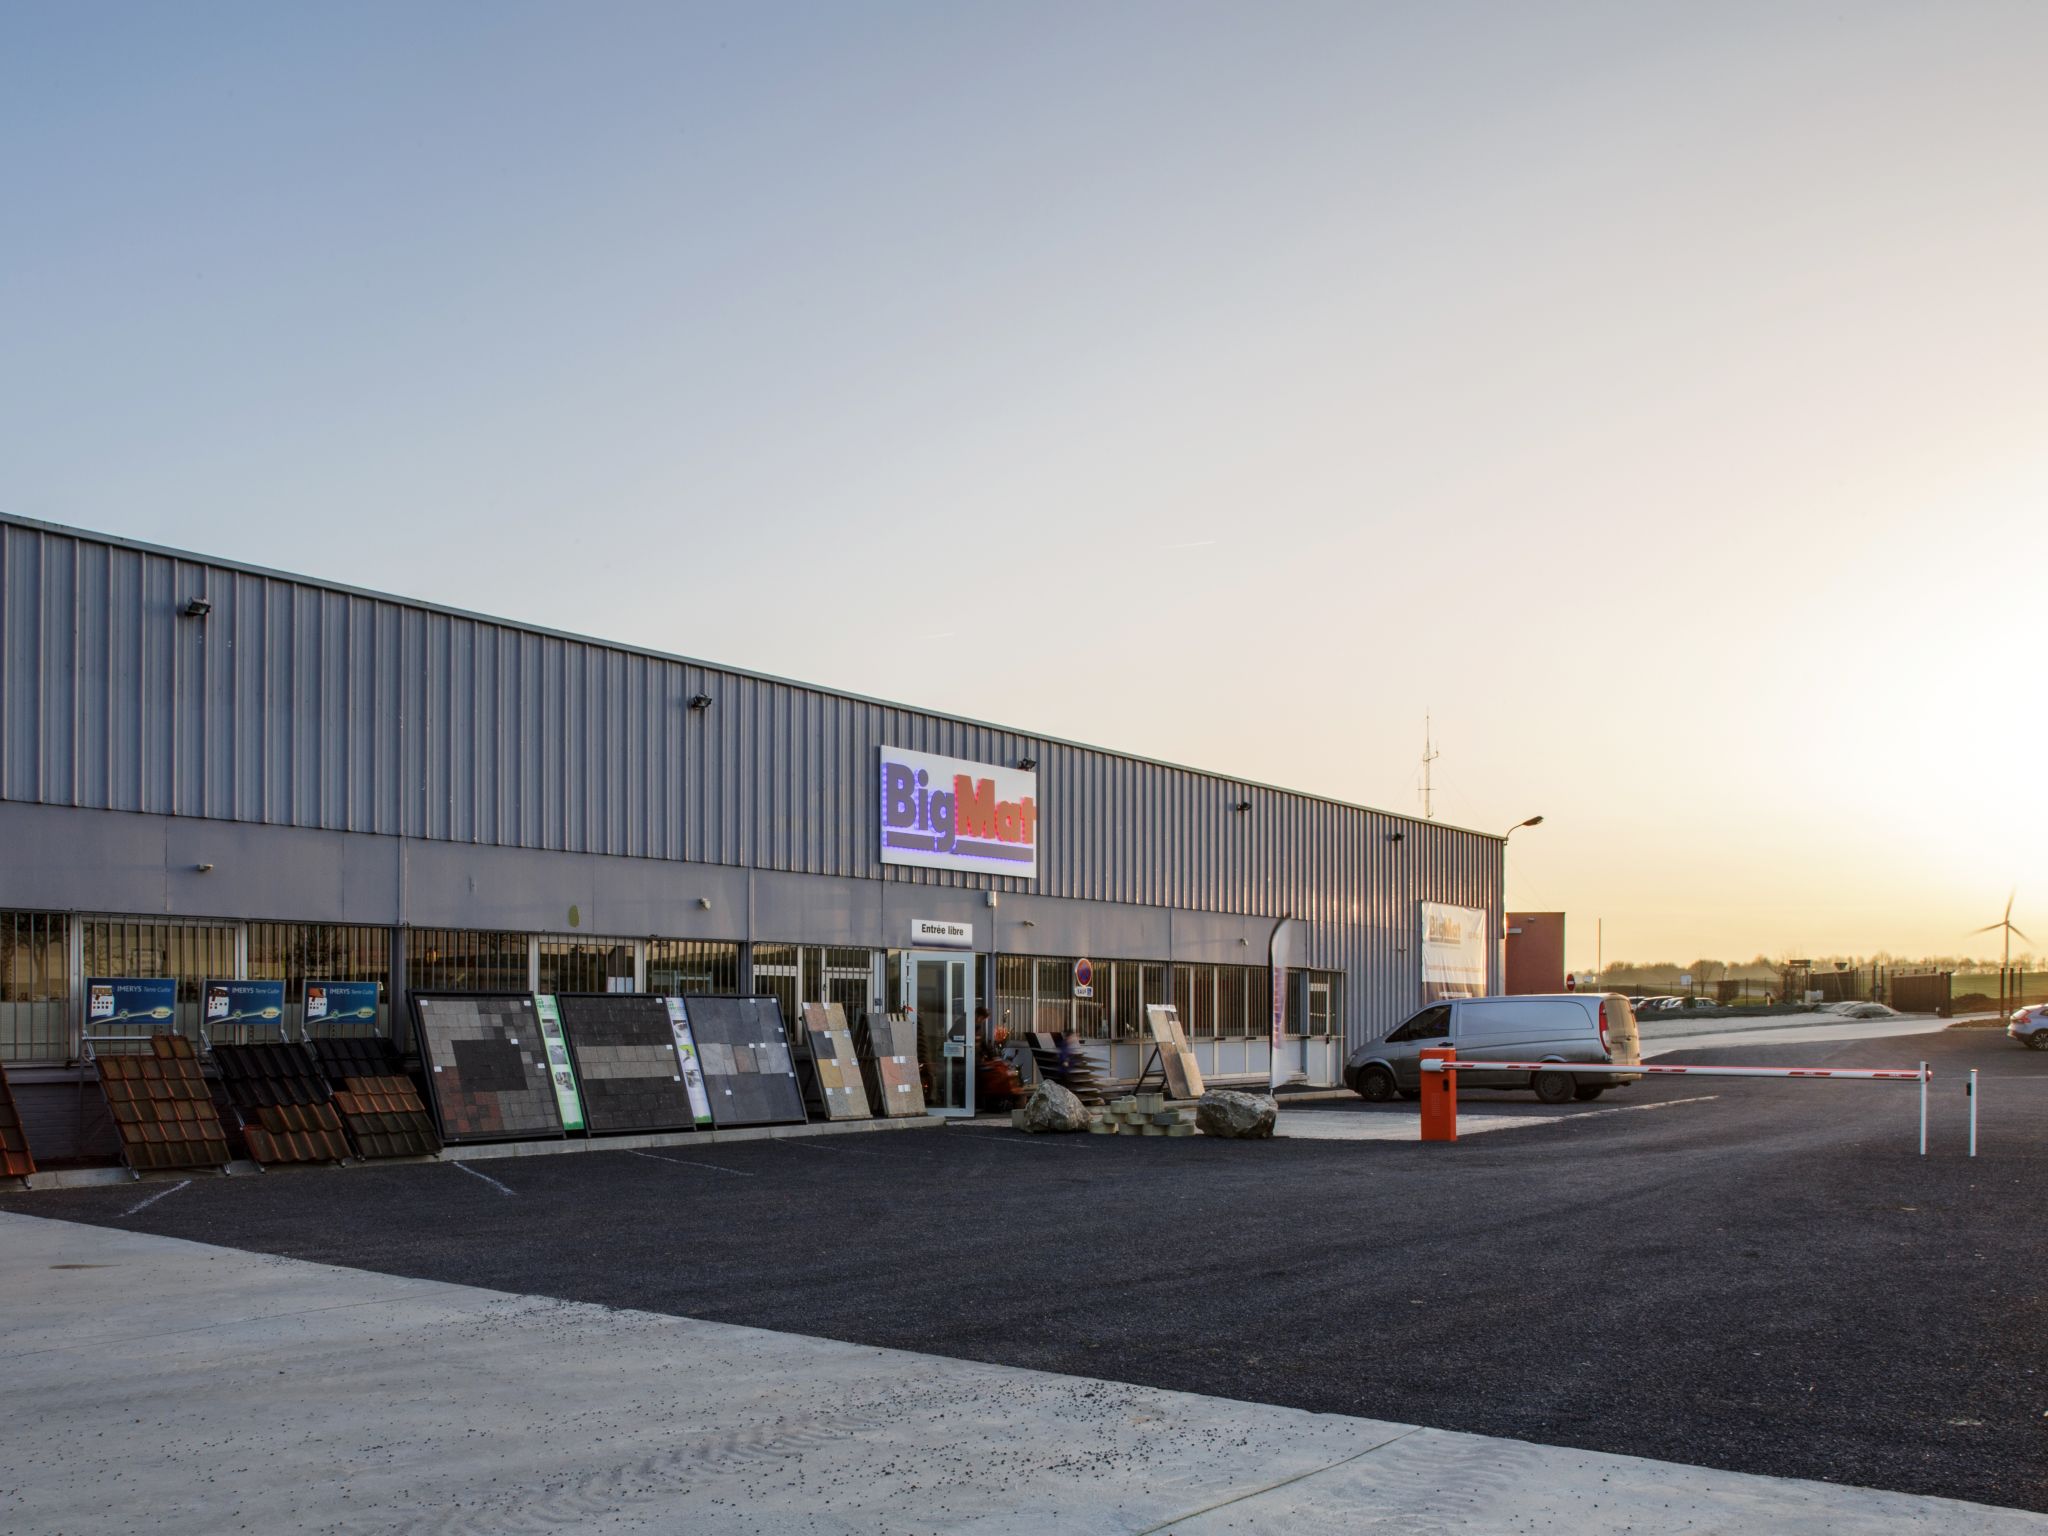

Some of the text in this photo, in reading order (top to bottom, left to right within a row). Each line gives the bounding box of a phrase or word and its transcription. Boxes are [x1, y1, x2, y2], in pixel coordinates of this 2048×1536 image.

[882, 762, 1037, 853] BigMat
[921, 923, 964, 936] Entrée libre
[117, 985, 142, 993] IMERYS
